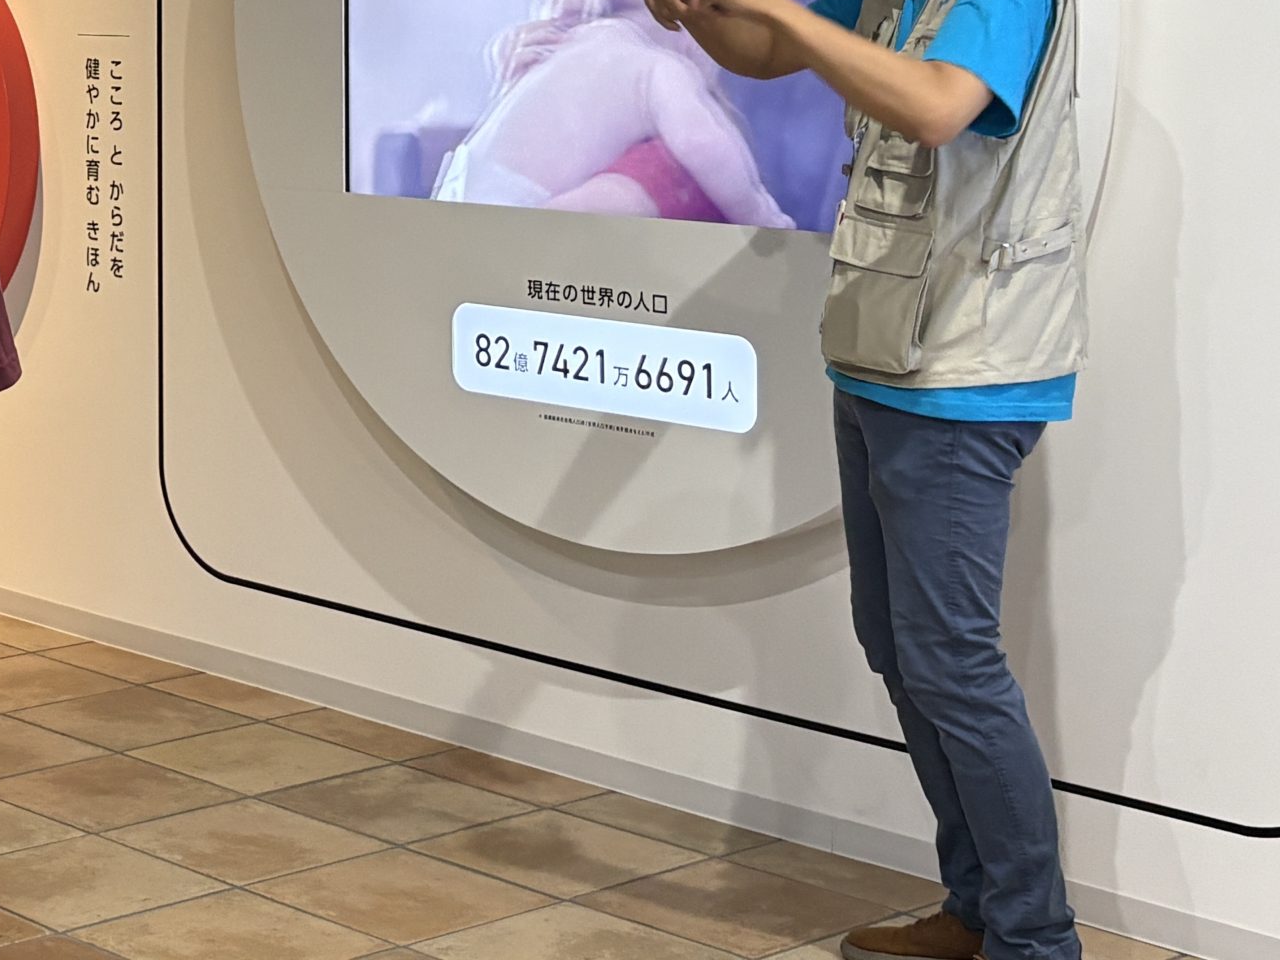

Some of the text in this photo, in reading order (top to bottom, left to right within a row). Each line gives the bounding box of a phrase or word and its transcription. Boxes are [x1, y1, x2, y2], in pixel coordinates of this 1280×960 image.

[110, 60, 123, 132] こころ
[86, 220, 100, 293] きほん
[526, 279, 668, 314] 現在の世界の人口
